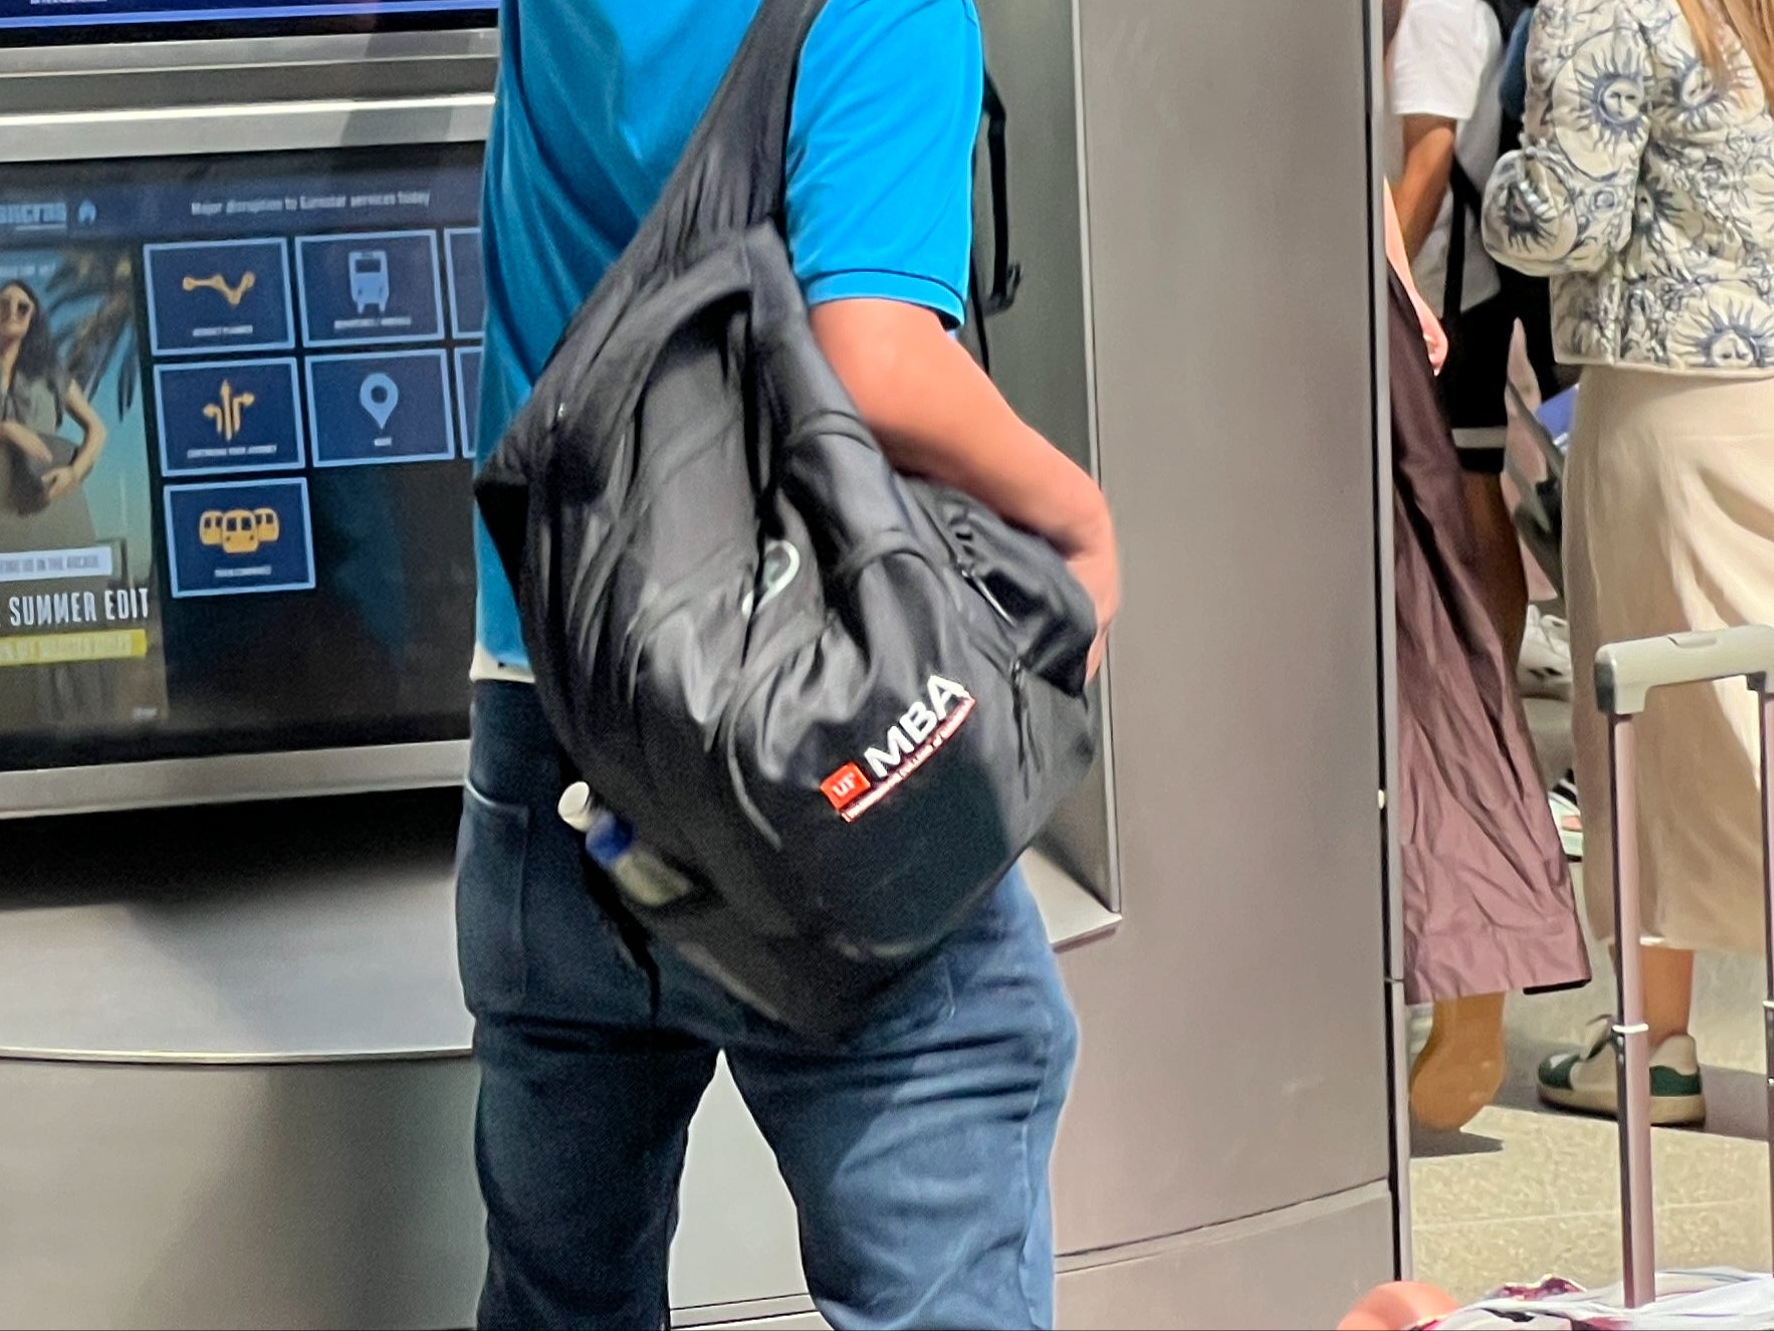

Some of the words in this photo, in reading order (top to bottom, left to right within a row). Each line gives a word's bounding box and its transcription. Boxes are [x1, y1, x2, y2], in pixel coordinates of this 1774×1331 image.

[9, 591, 97, 627] SUMMER
[104, 587, 149, 621] EDIT
[863, 675, 972, 779] MBA
